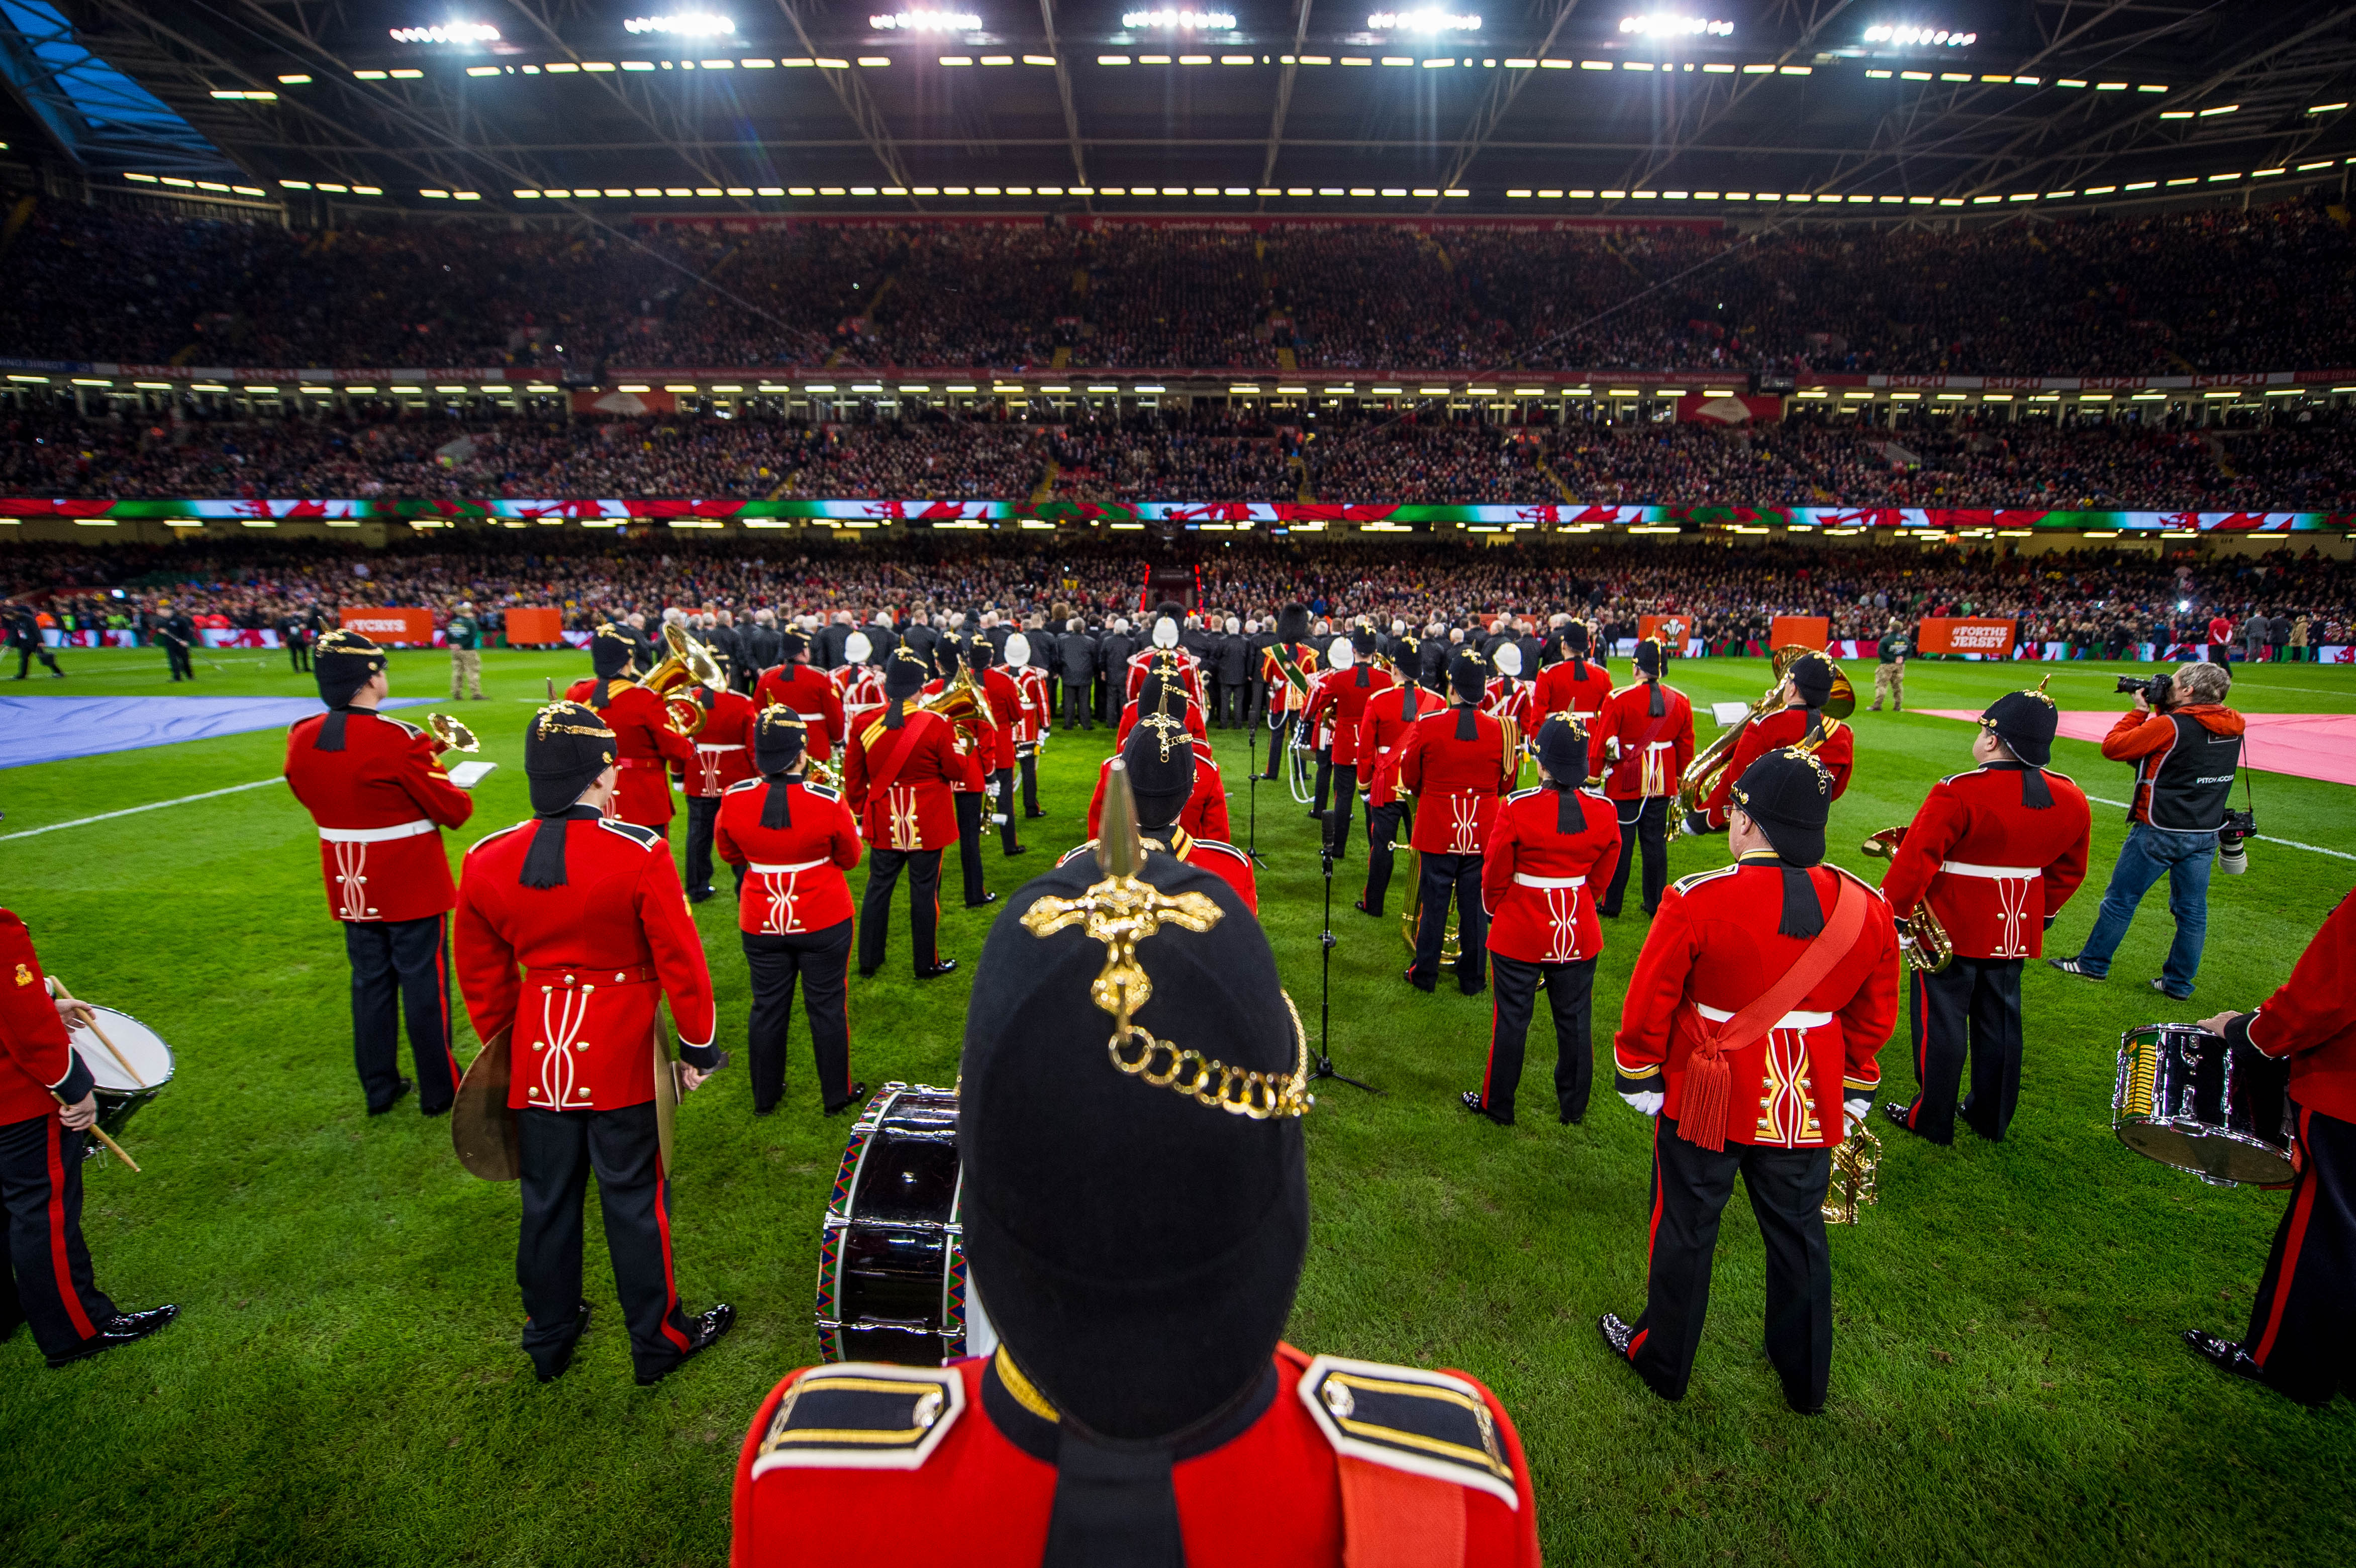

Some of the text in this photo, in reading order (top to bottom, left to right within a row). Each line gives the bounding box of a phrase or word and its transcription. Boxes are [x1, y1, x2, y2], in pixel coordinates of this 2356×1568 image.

[1886, 375, 1945, 386] ISUZU
[1982, 377, 2041, 388] ISUZU
[2080, 377, 2145, 388] ISUZU
[2192, 373, 2267, 387] ISUZU
[345, 619, 406, 632] #YCRYS
[1952, 627, 2008, 637] #FORTHE
[1950, 636, 2007, 648] JERSEY
